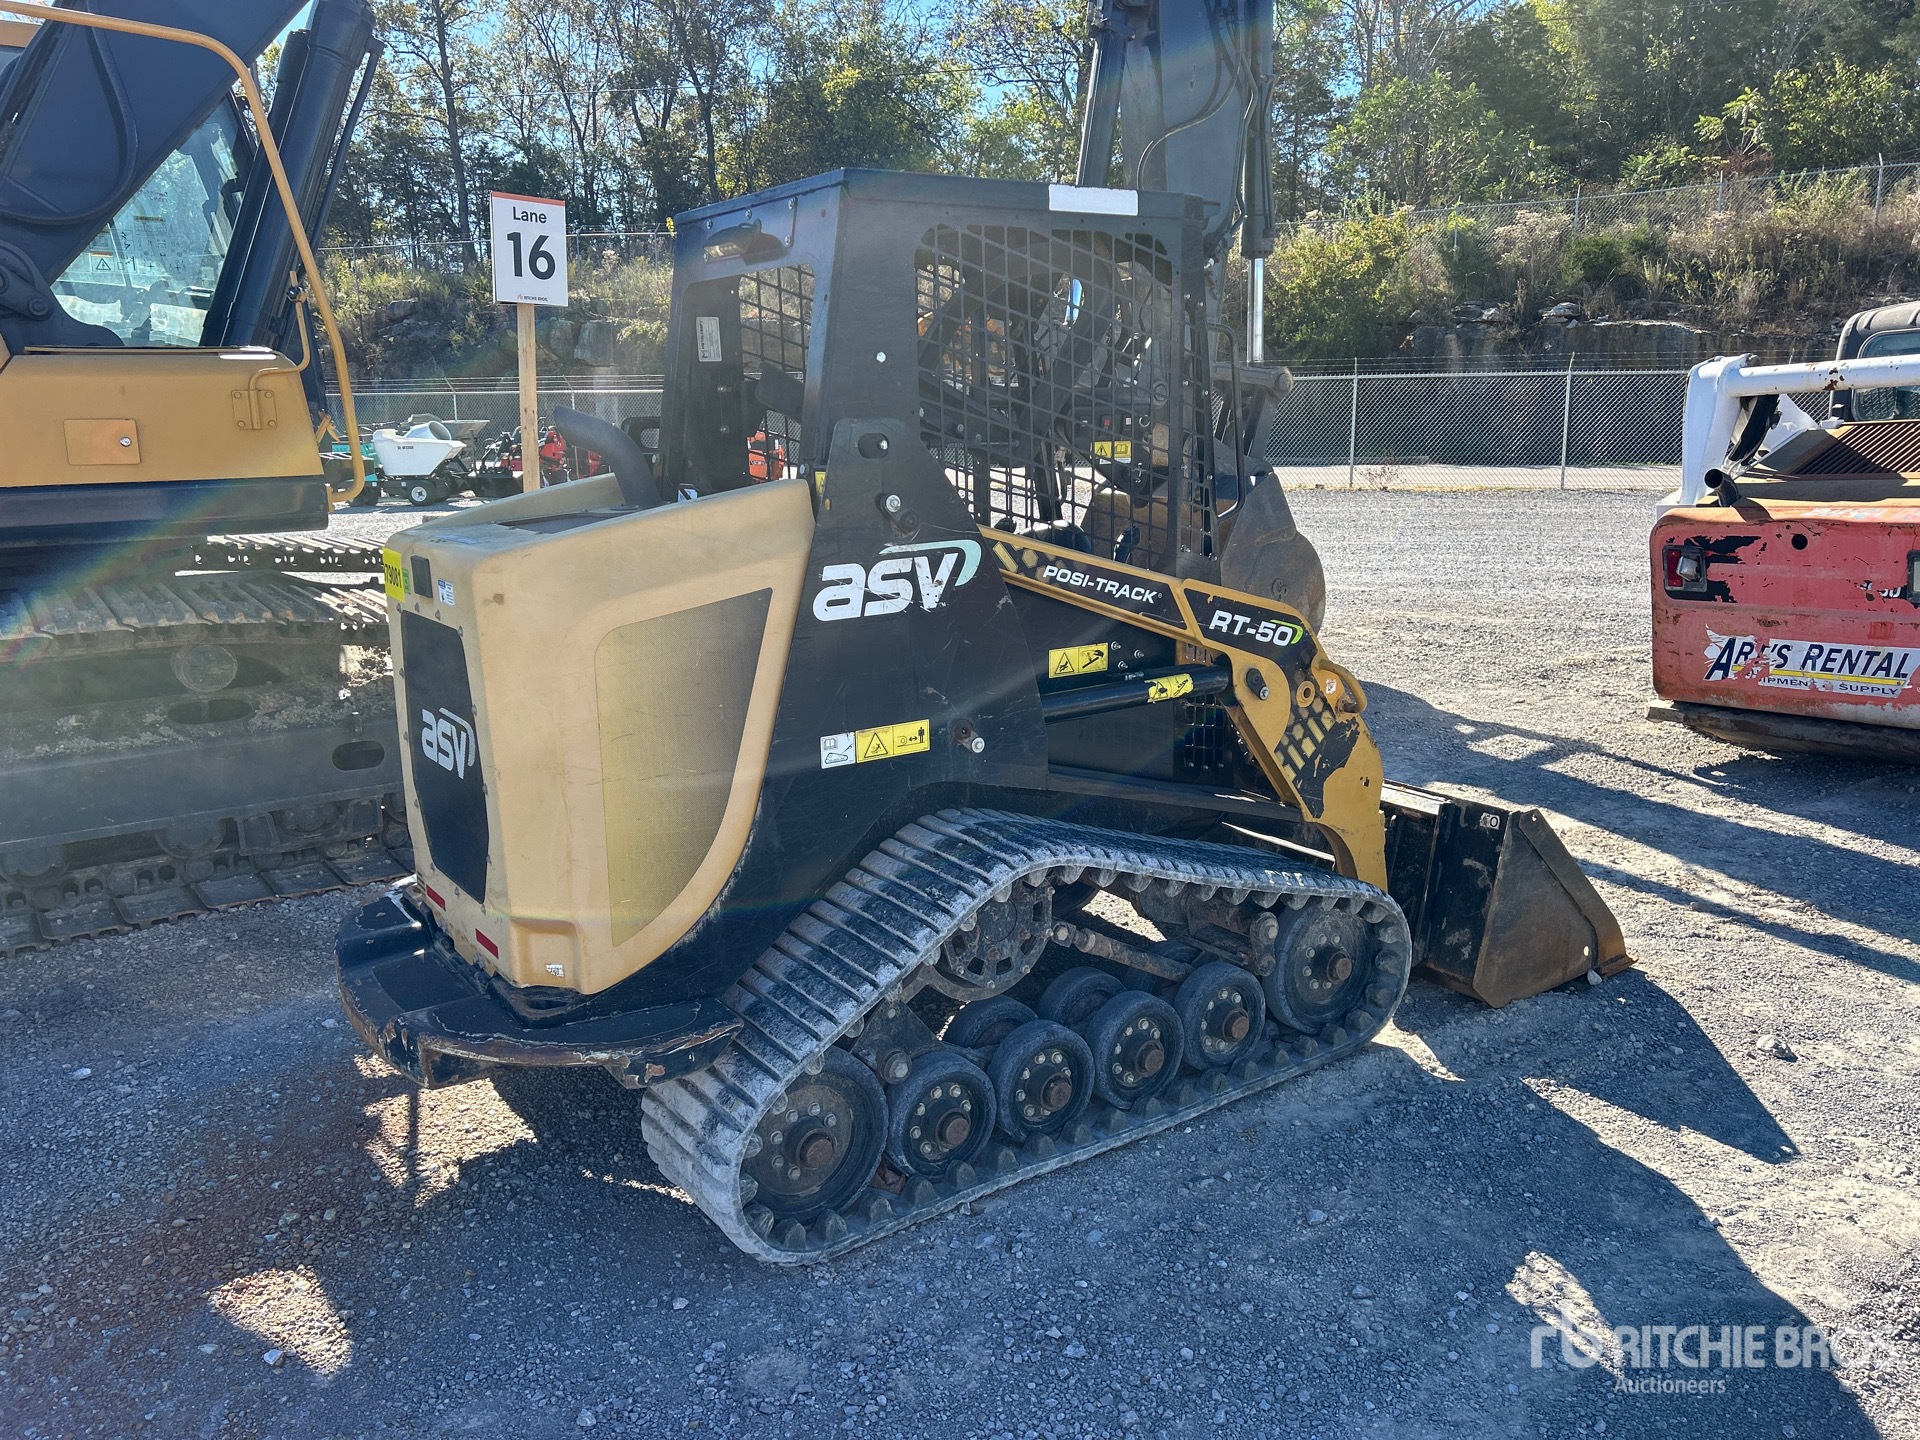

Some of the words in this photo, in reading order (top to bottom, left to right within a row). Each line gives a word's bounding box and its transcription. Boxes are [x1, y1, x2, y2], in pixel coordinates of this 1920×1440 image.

[512, 206, 547, 224] Lane
[506, 231, 556, 281] 16
[384, 563, 403, 589] 79081
[1209, 610, 1294, 648] RT-50
[1801, 643, 1910, 679] RENTAL
[1839, 683, 1899, 696] SUPPLY
